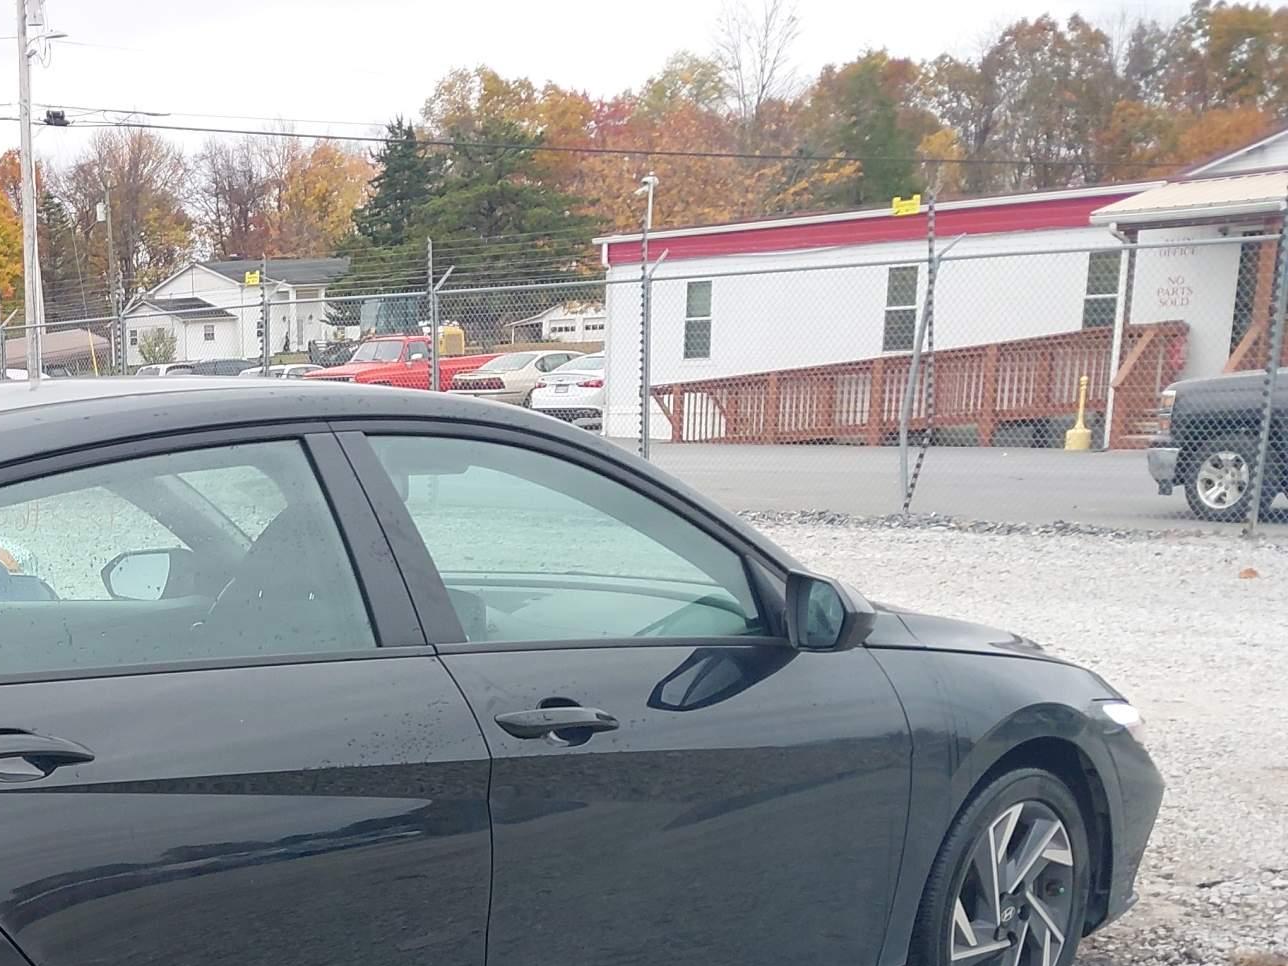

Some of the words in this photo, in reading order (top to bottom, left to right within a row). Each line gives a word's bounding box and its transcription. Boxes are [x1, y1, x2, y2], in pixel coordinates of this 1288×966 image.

[1168, 275, 1185, 285] NO
[1157, 287, 1194, 297] PARTS
[1159, 297, 1190, 307] SOLD
